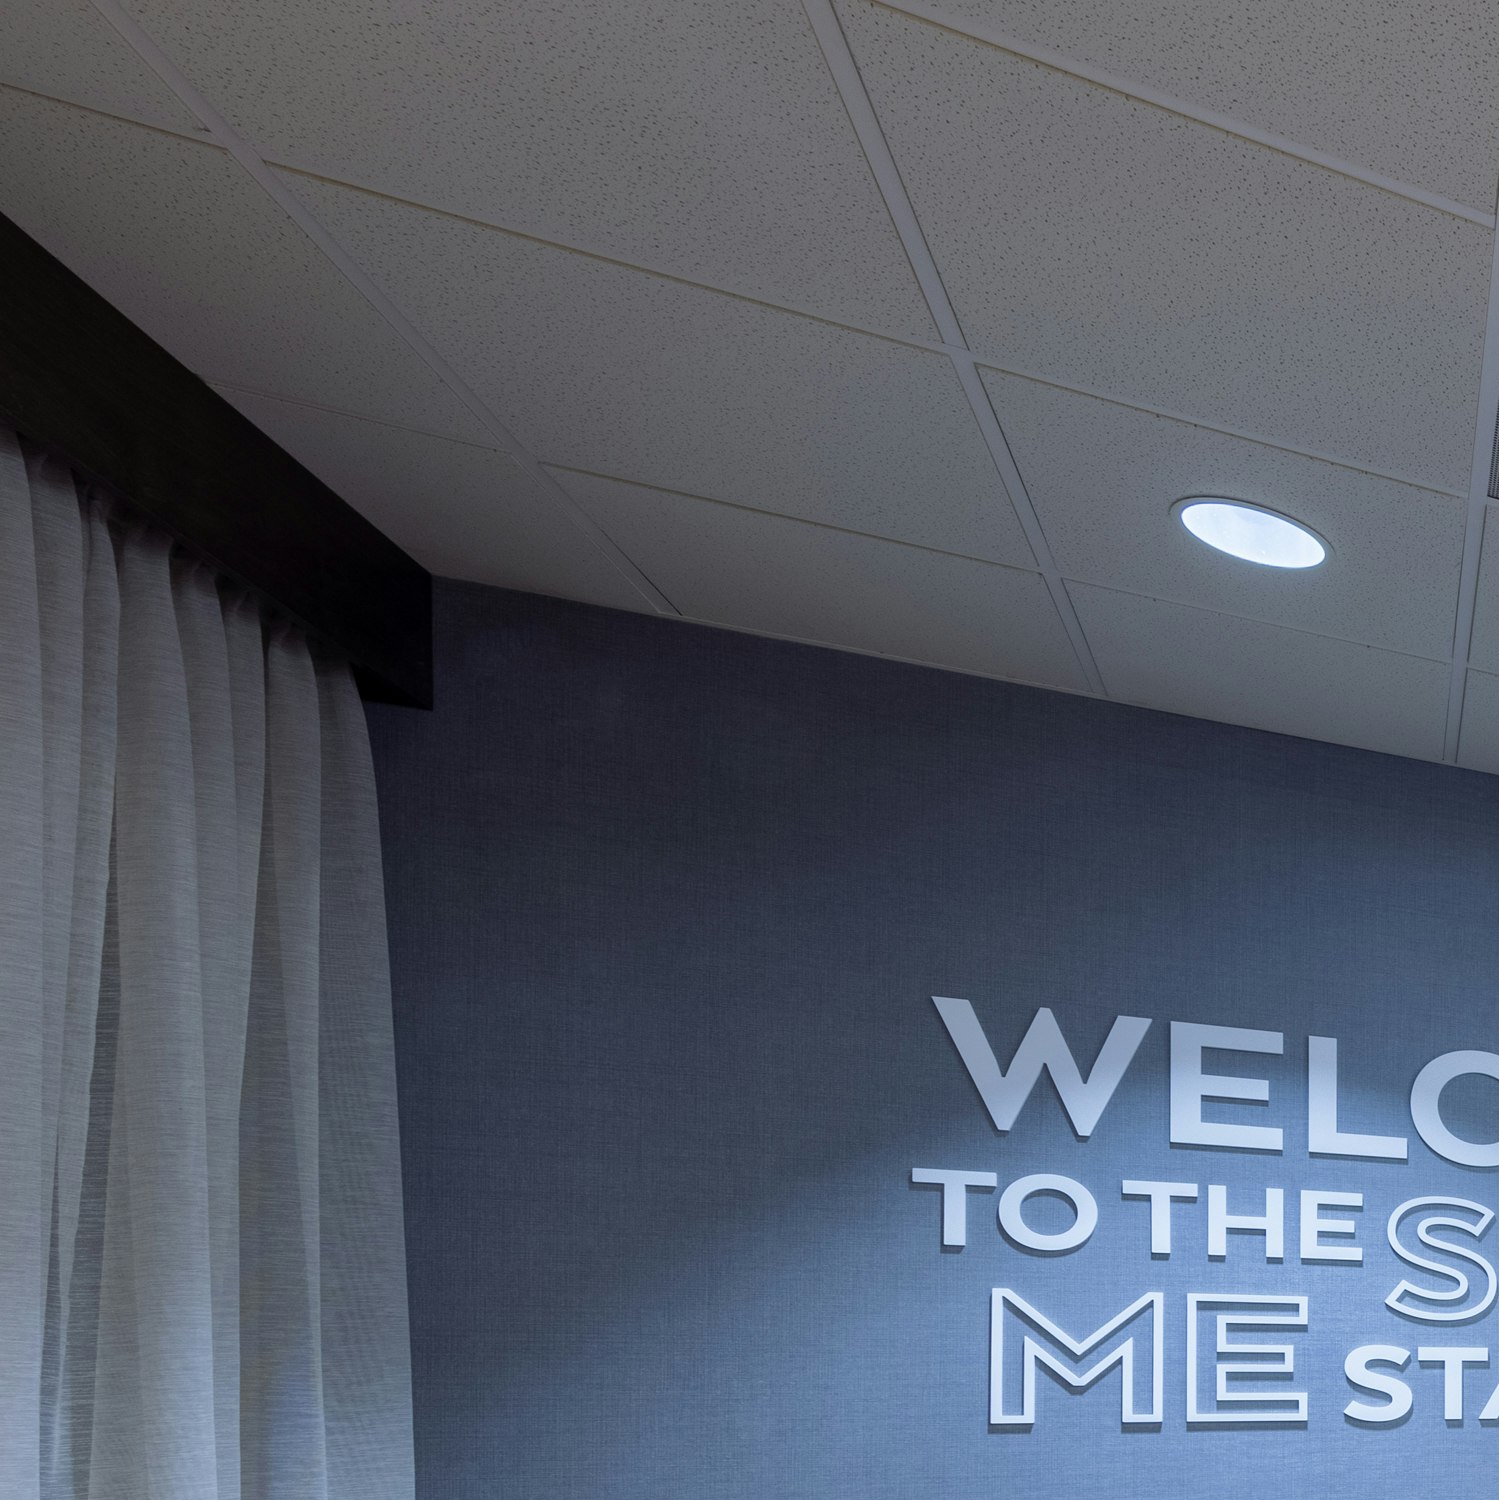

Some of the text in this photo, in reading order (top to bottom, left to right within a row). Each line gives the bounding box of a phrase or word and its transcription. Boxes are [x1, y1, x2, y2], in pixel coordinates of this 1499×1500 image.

[911, 1168, 1099, 1251] TO
[1123, 1179, 1364, 1261] THE
[989, 1288, 1309, 1424] ME
